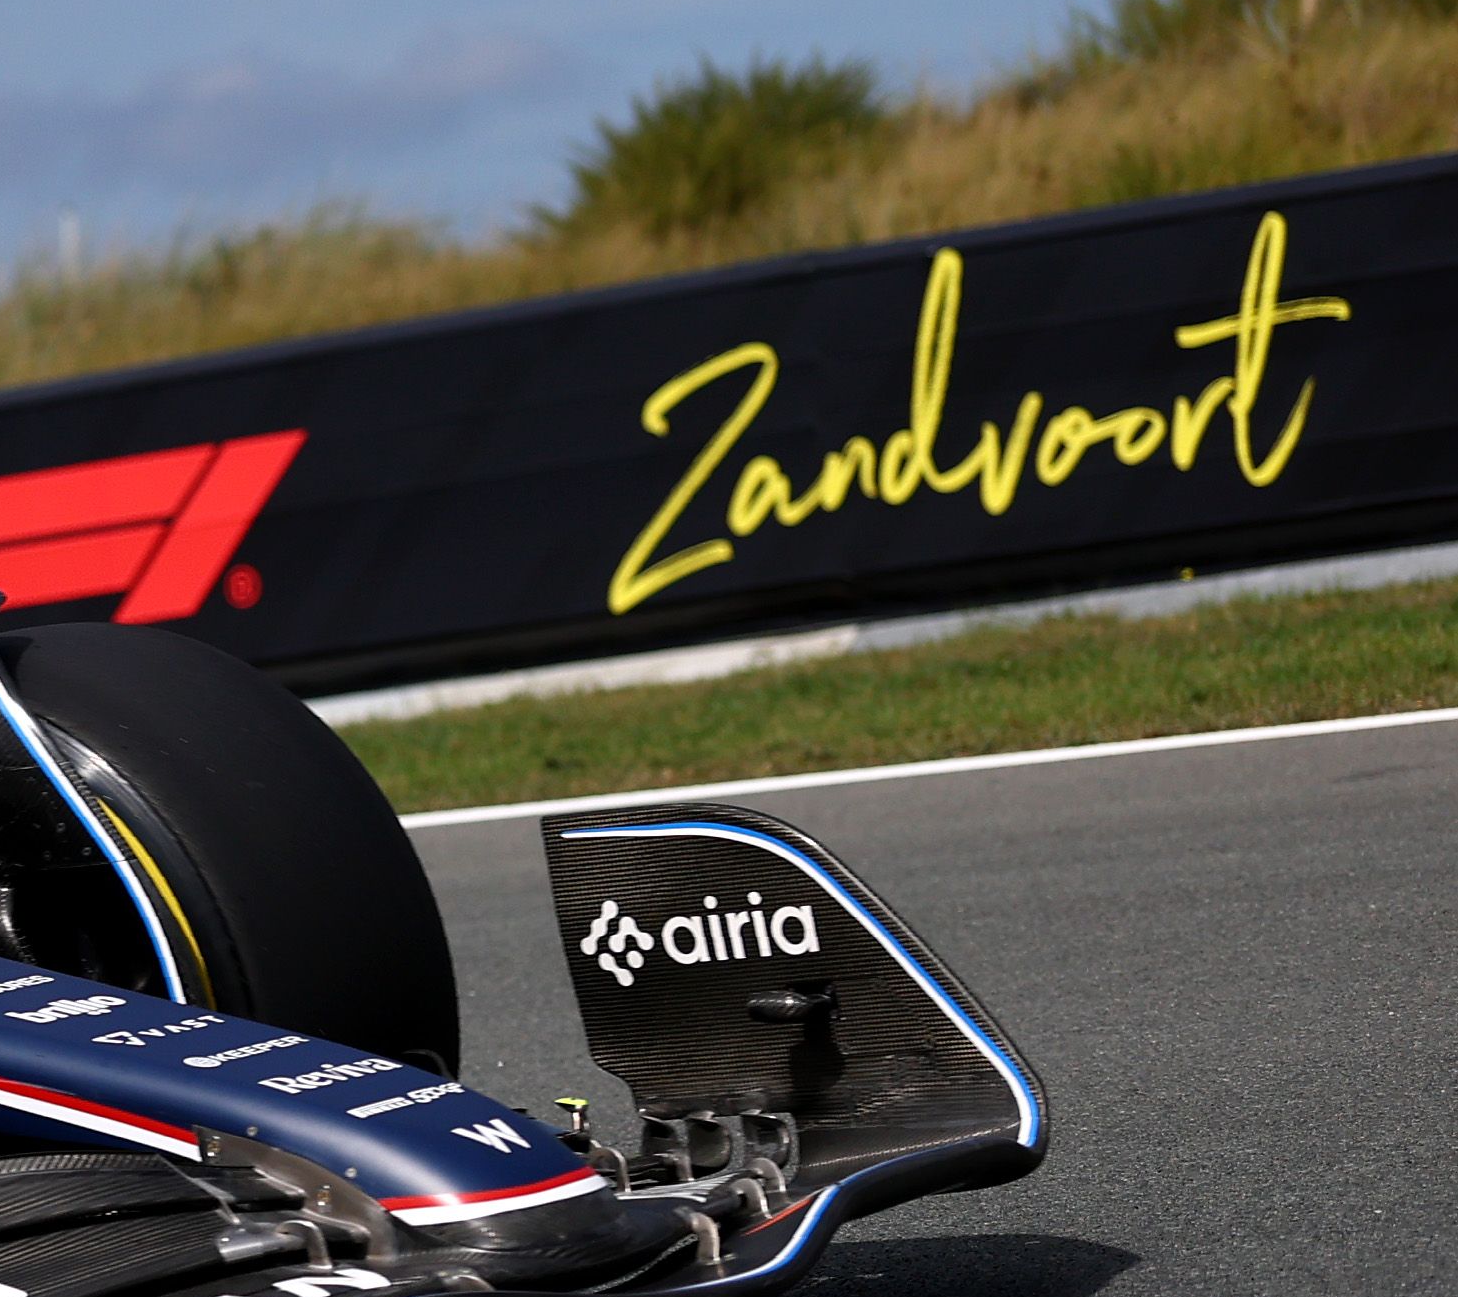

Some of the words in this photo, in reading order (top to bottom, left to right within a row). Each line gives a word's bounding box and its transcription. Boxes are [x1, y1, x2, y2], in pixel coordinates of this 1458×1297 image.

[607, 211, 1351, 615] Zandvoort
[660, 891, 821, 965] airia
[137, 1014, 226, 1037] VAST
[208, 1034, 311, 1062] KEEPER
[257, 1057, 404, 1095] Reviva
